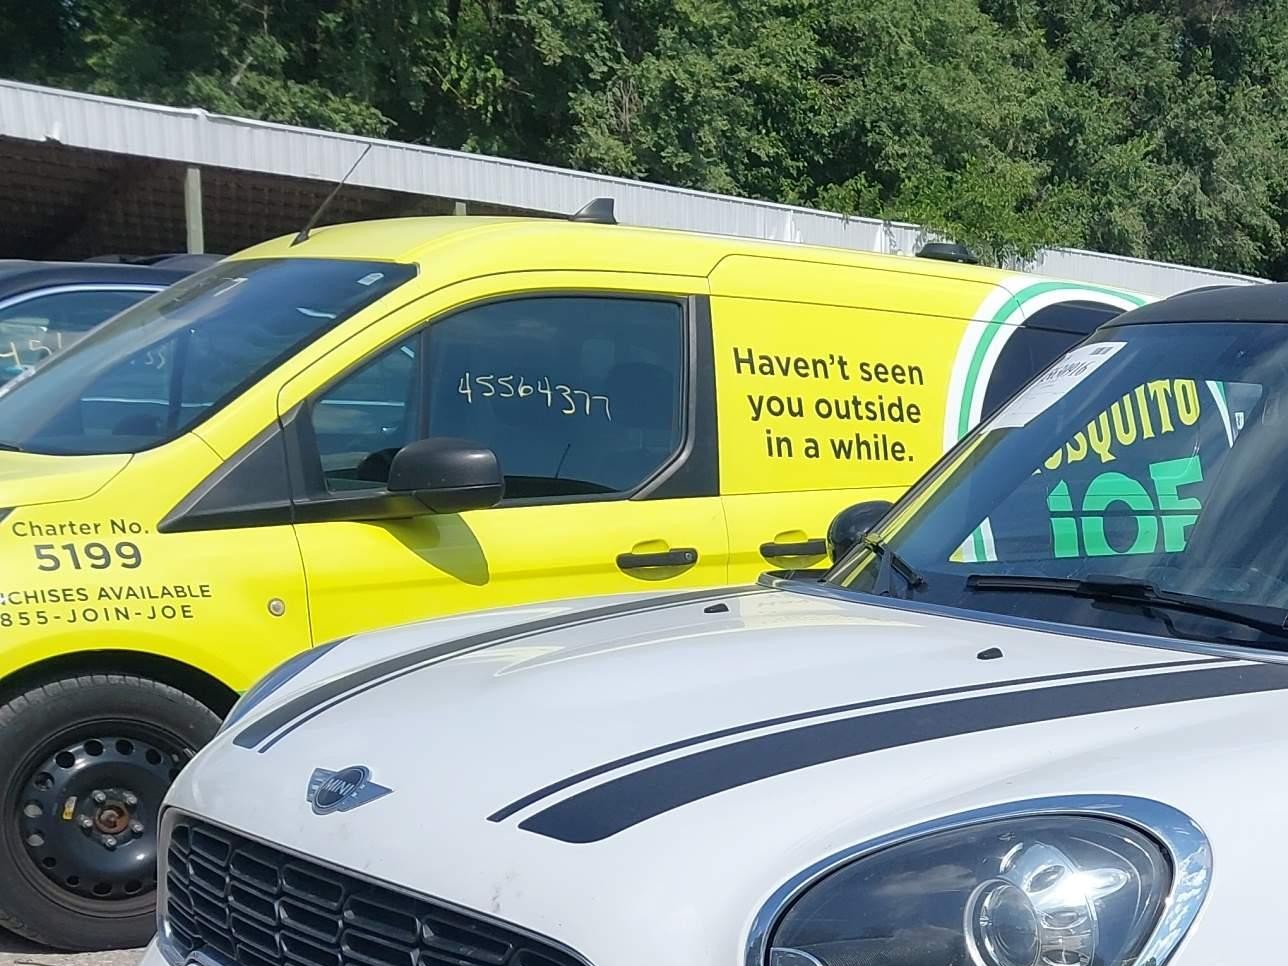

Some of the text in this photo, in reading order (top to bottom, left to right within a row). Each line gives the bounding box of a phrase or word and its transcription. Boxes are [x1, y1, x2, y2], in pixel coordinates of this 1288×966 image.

[733, 347, 924, 385] Haven’t seen
[458, 372, 612, 421] 45564377
[747, 394, 921, 423] you outside
[1032, 379, 1201, 475] SQUITO
[766, 429, 914, 462] in a while.
[12, 519, 149, 537] Charter No.
[34, 541, 142, 571] 5199
[98, 584, 212, 601] AVAILABLE
